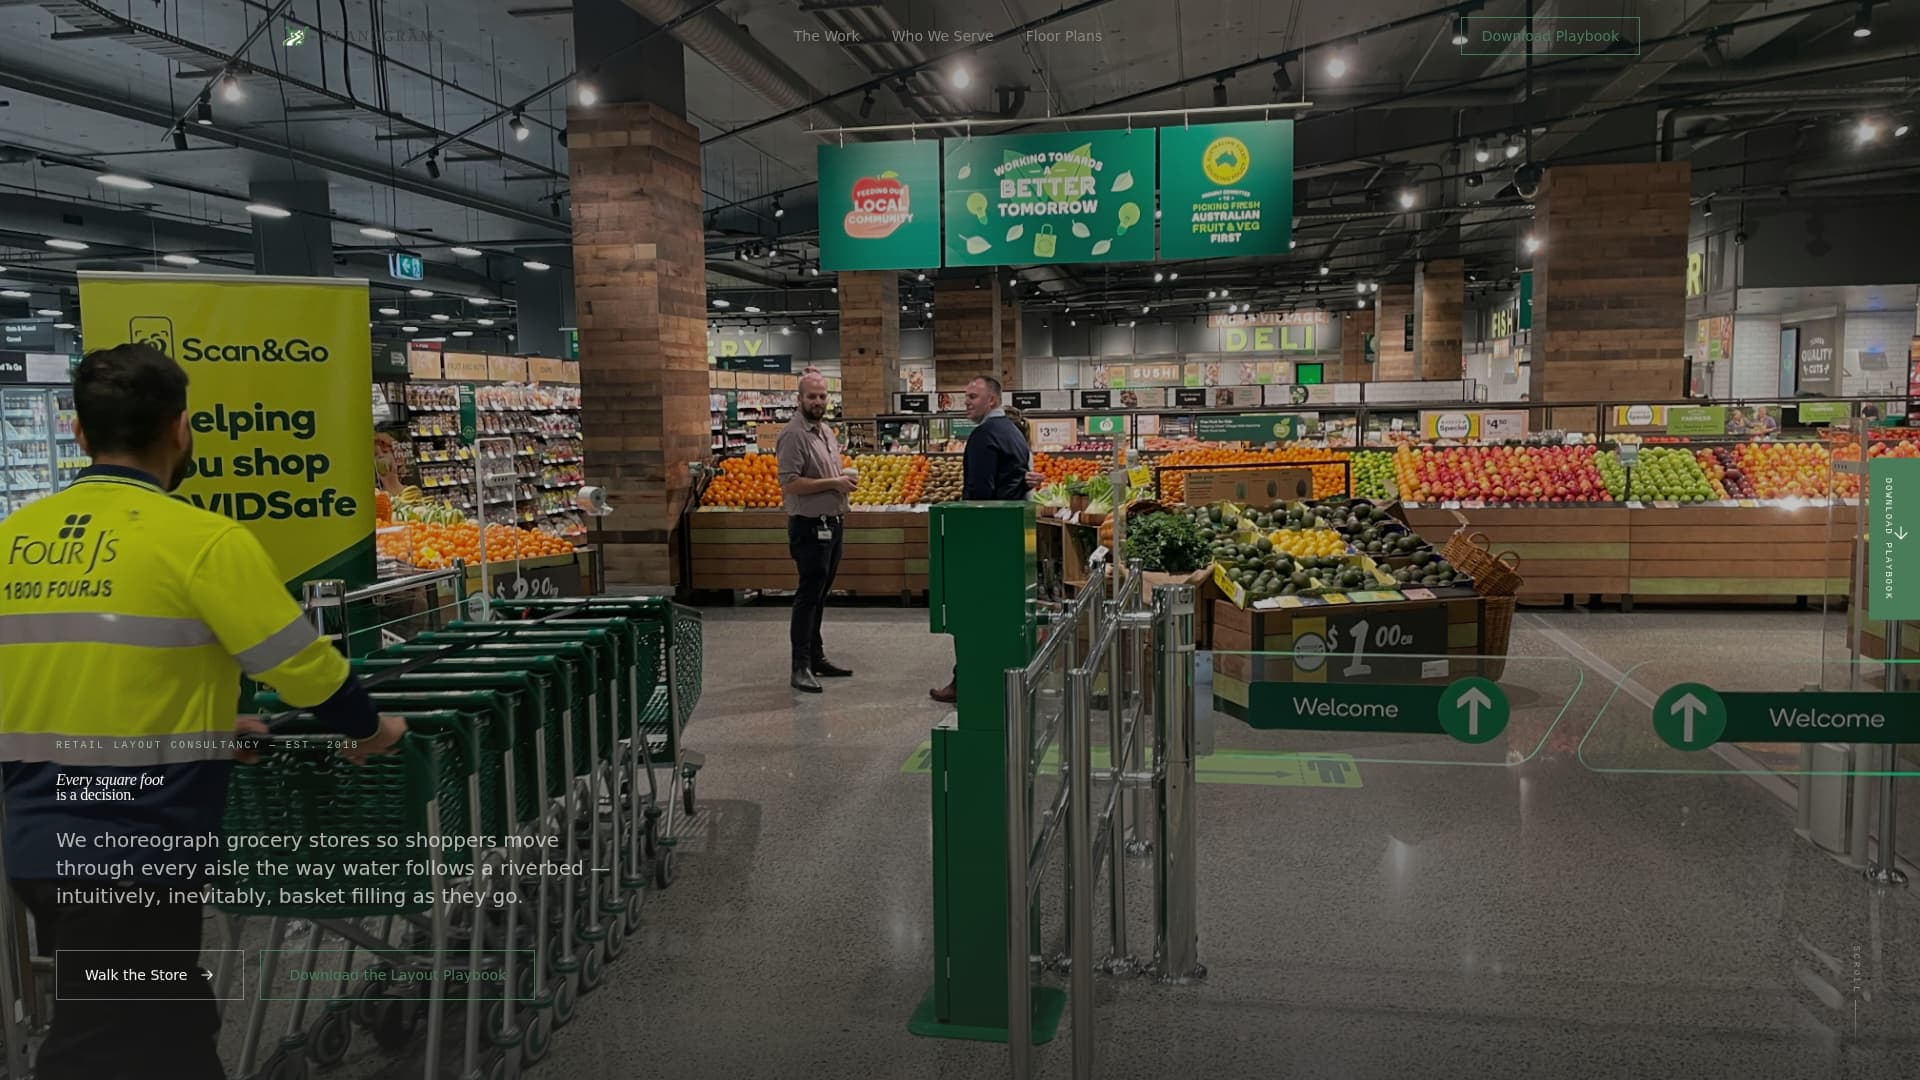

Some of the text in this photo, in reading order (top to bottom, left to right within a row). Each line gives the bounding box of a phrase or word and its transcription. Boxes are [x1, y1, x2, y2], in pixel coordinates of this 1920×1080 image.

[994, 152, 1103, 176] WORKING TOWARDS
[1043, 166, 1052, 175] A
[856, 187, 888, 198] FEEDING
[1000, 176, 1096, 199] BETTER
[854, 198, 909, 212] LOCAL
[998, 200, 1098, 217] TOMORROW
[1192, 201, 1260, 212] PICKING FRESH
[848, 212, 914, 225] COMMUNITY
[1192, 210, 1260, 222] AUSTRALIAN
[1192, 221, 1260, 233] FRUIT & VEG
[1210, 233, 1242, 244] FIRST
[1491, 308, 1513, 339] FISH
[1225, 325, 1313, 352] DELI
[182, 338, 330, 363] Scan&Go
[1801, 348, 1832, 362] QUALITY
[1133, 367, 1177, 379] SUSHI
[190, 403, 316, 441] elping
[1438, 424, 1468, 434] Special
[183, 448, 330, 483] ou shop
[172, 488, 358, 521] VIDSafe
[8, 535, 84, 566] FOUR
[4, 579, 112, 600] 1800 FOURJS
[1293, 697, 1399, 718] Welcome
[1769, 708, 1885, 728] Welcome
